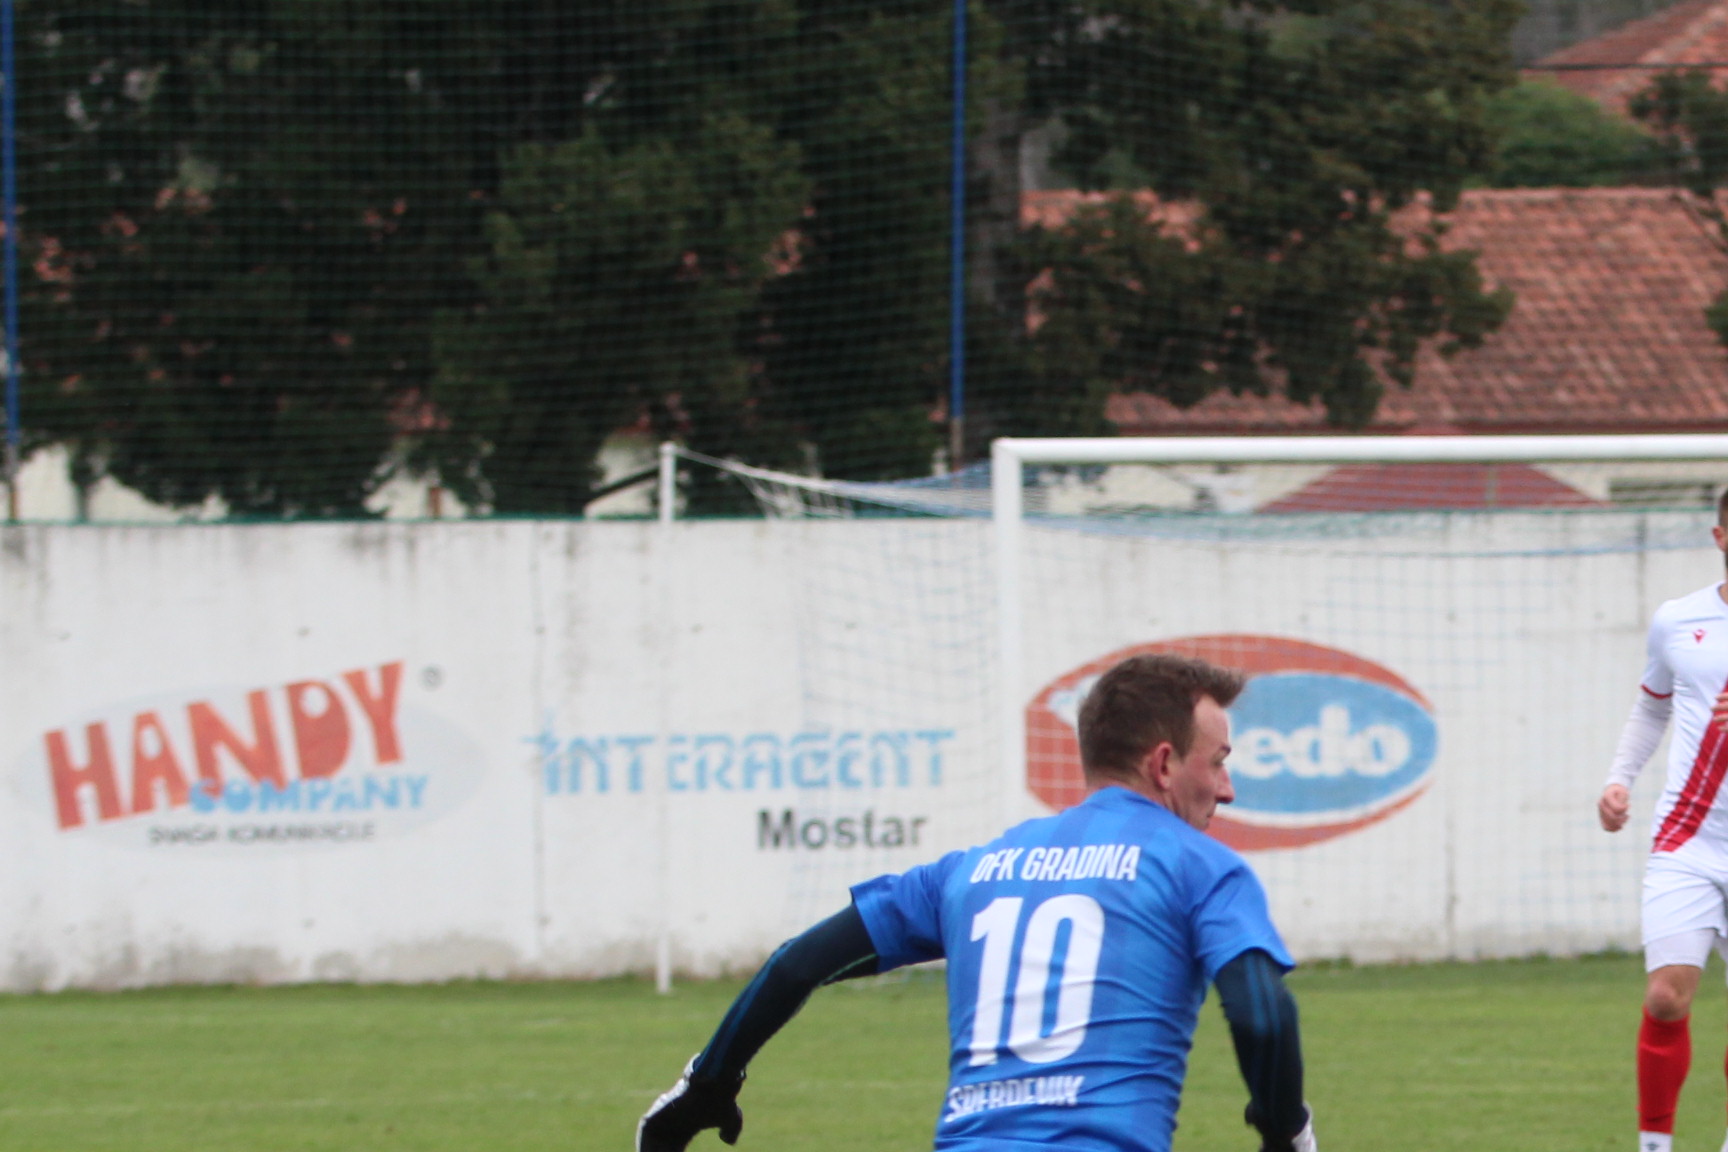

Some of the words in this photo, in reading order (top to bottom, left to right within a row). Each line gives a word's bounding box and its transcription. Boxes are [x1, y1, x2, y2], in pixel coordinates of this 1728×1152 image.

[43, 660, 405, 831] HANDY
[520, 712, 956, 795] INTERAGENT
[1222, 703, 1411, 780] edo
[186, 774, 430, 815] COMPANY
[757, 807, 928, 851] Mostar
[1020, 844, 1142, 882] GRADINA
[969, 894, 1106, 1067] 10
